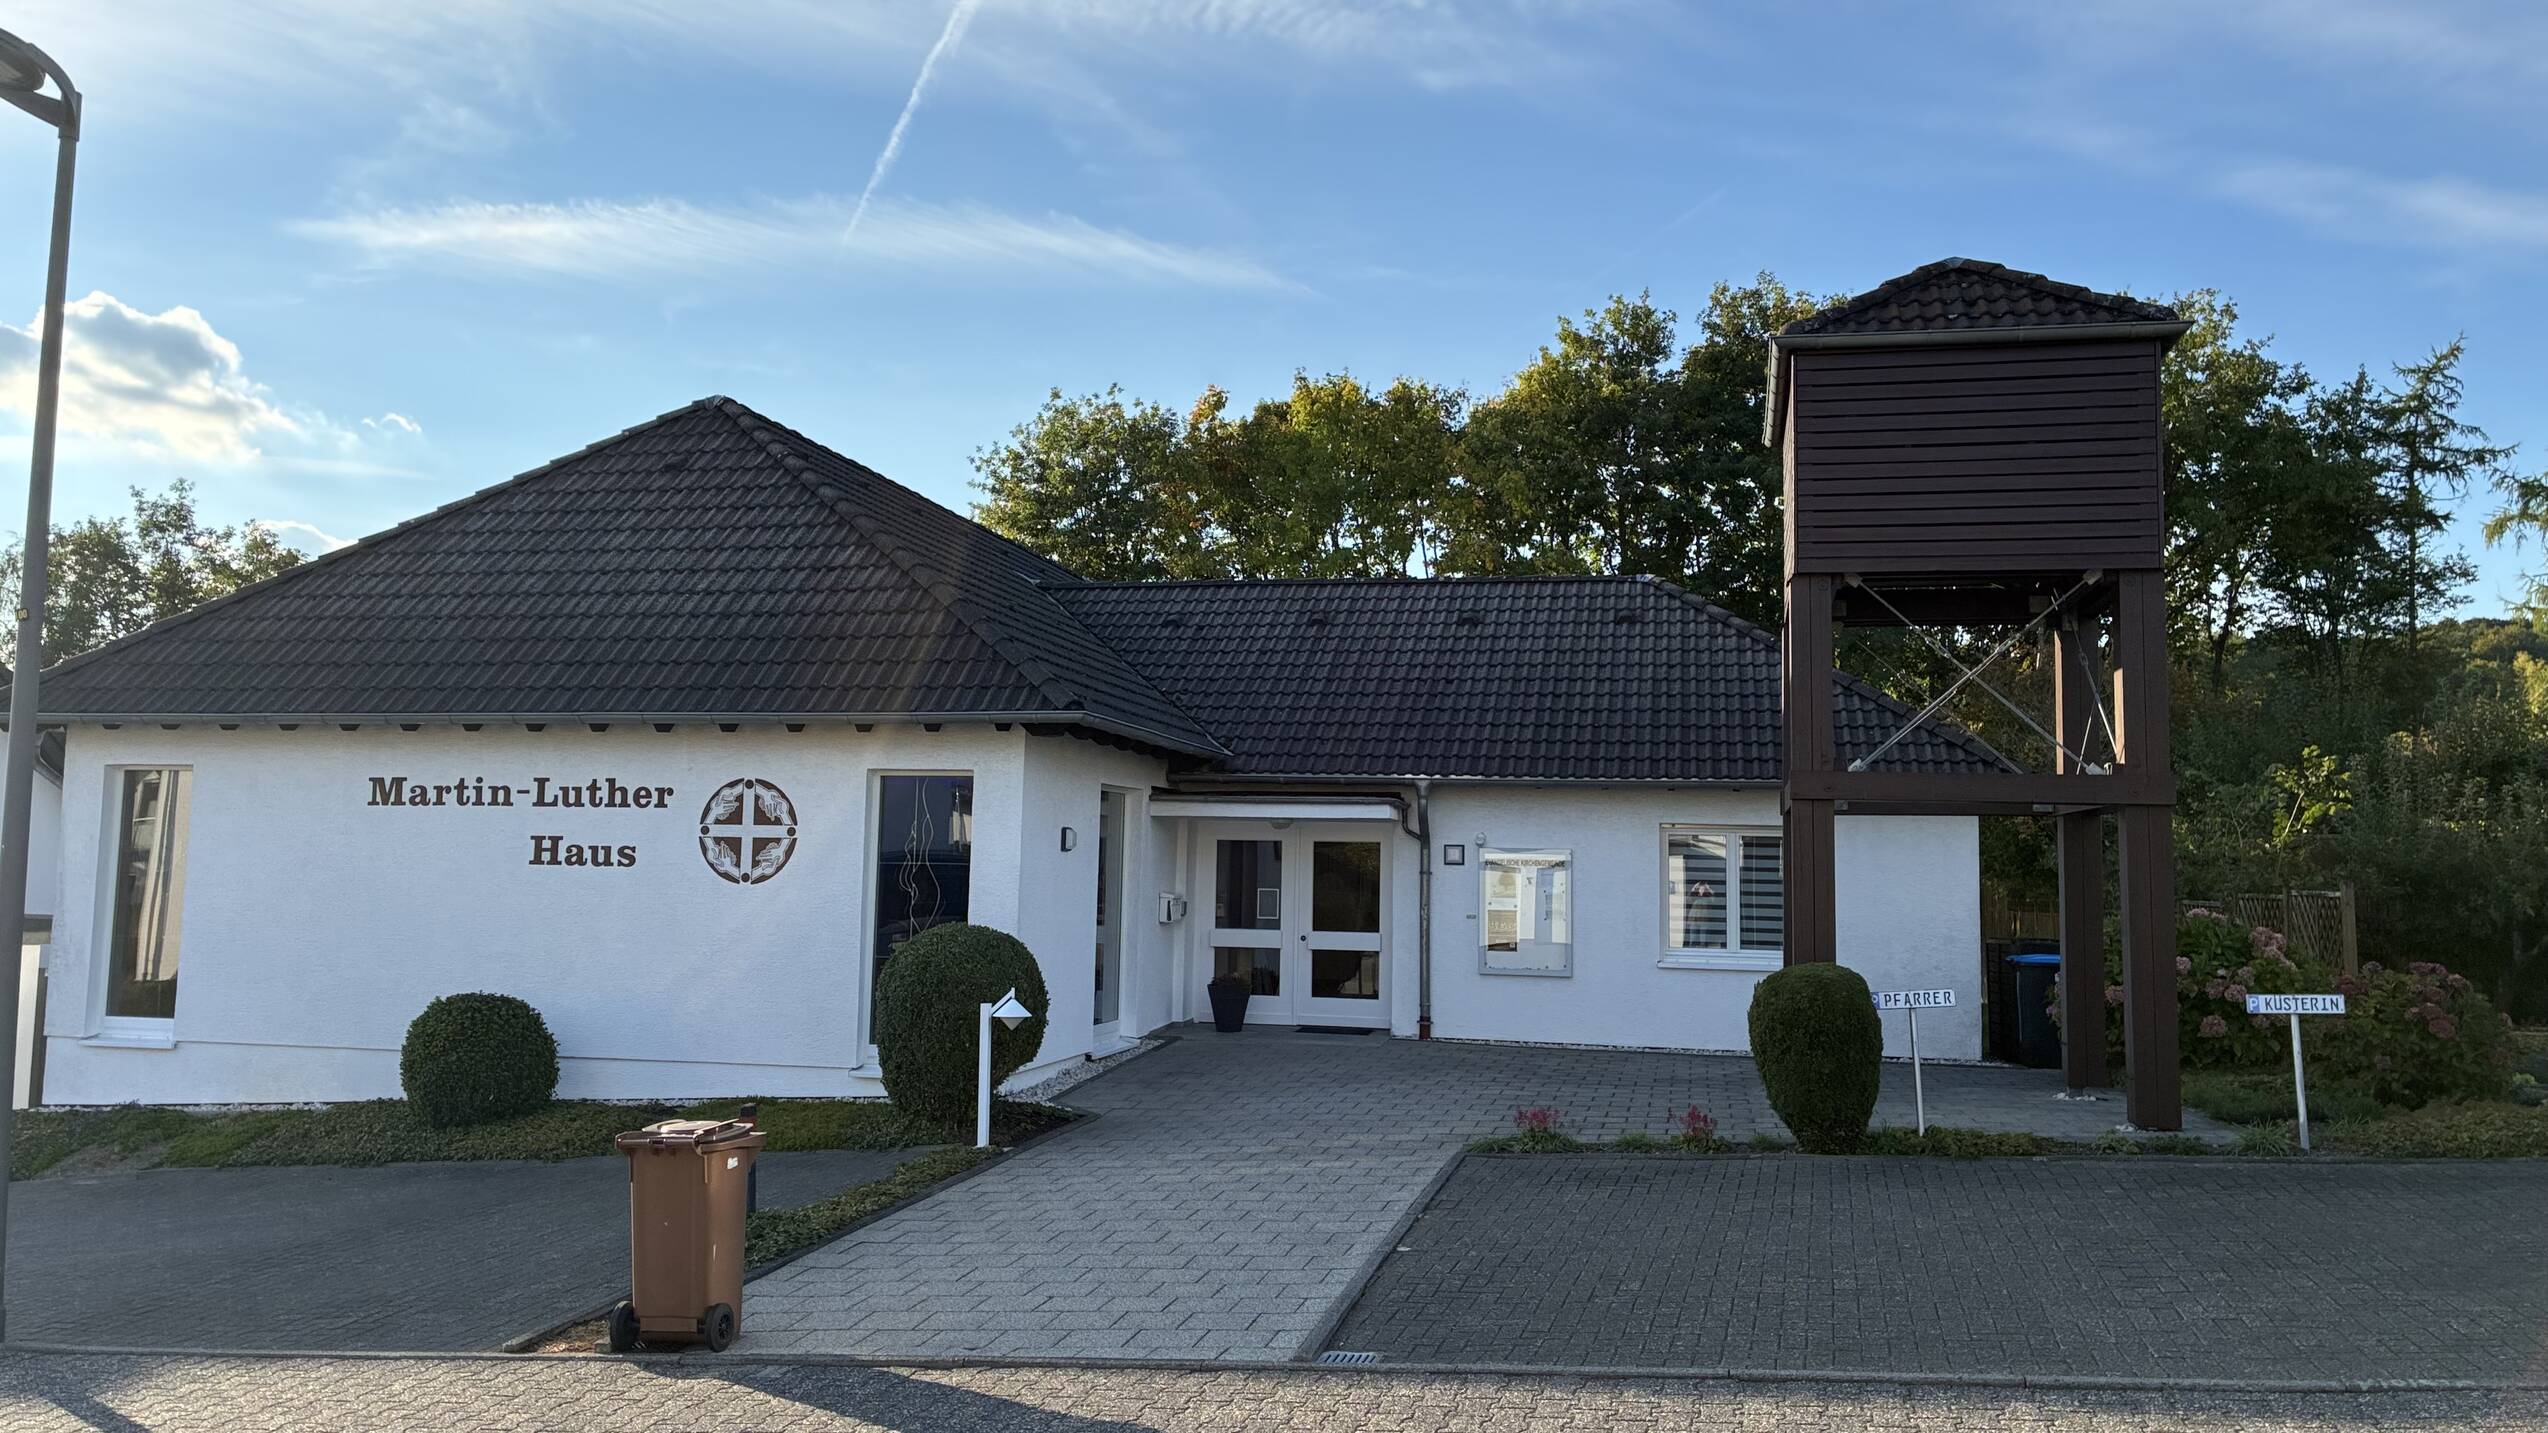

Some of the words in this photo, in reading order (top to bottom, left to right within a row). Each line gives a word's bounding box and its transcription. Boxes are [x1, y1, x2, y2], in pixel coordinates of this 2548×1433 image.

[367, 776, 674, 808] Martin-Luther
[528, 835, 637, 867] Haus
[1884, 991, 1952, 1007] PFARRER
